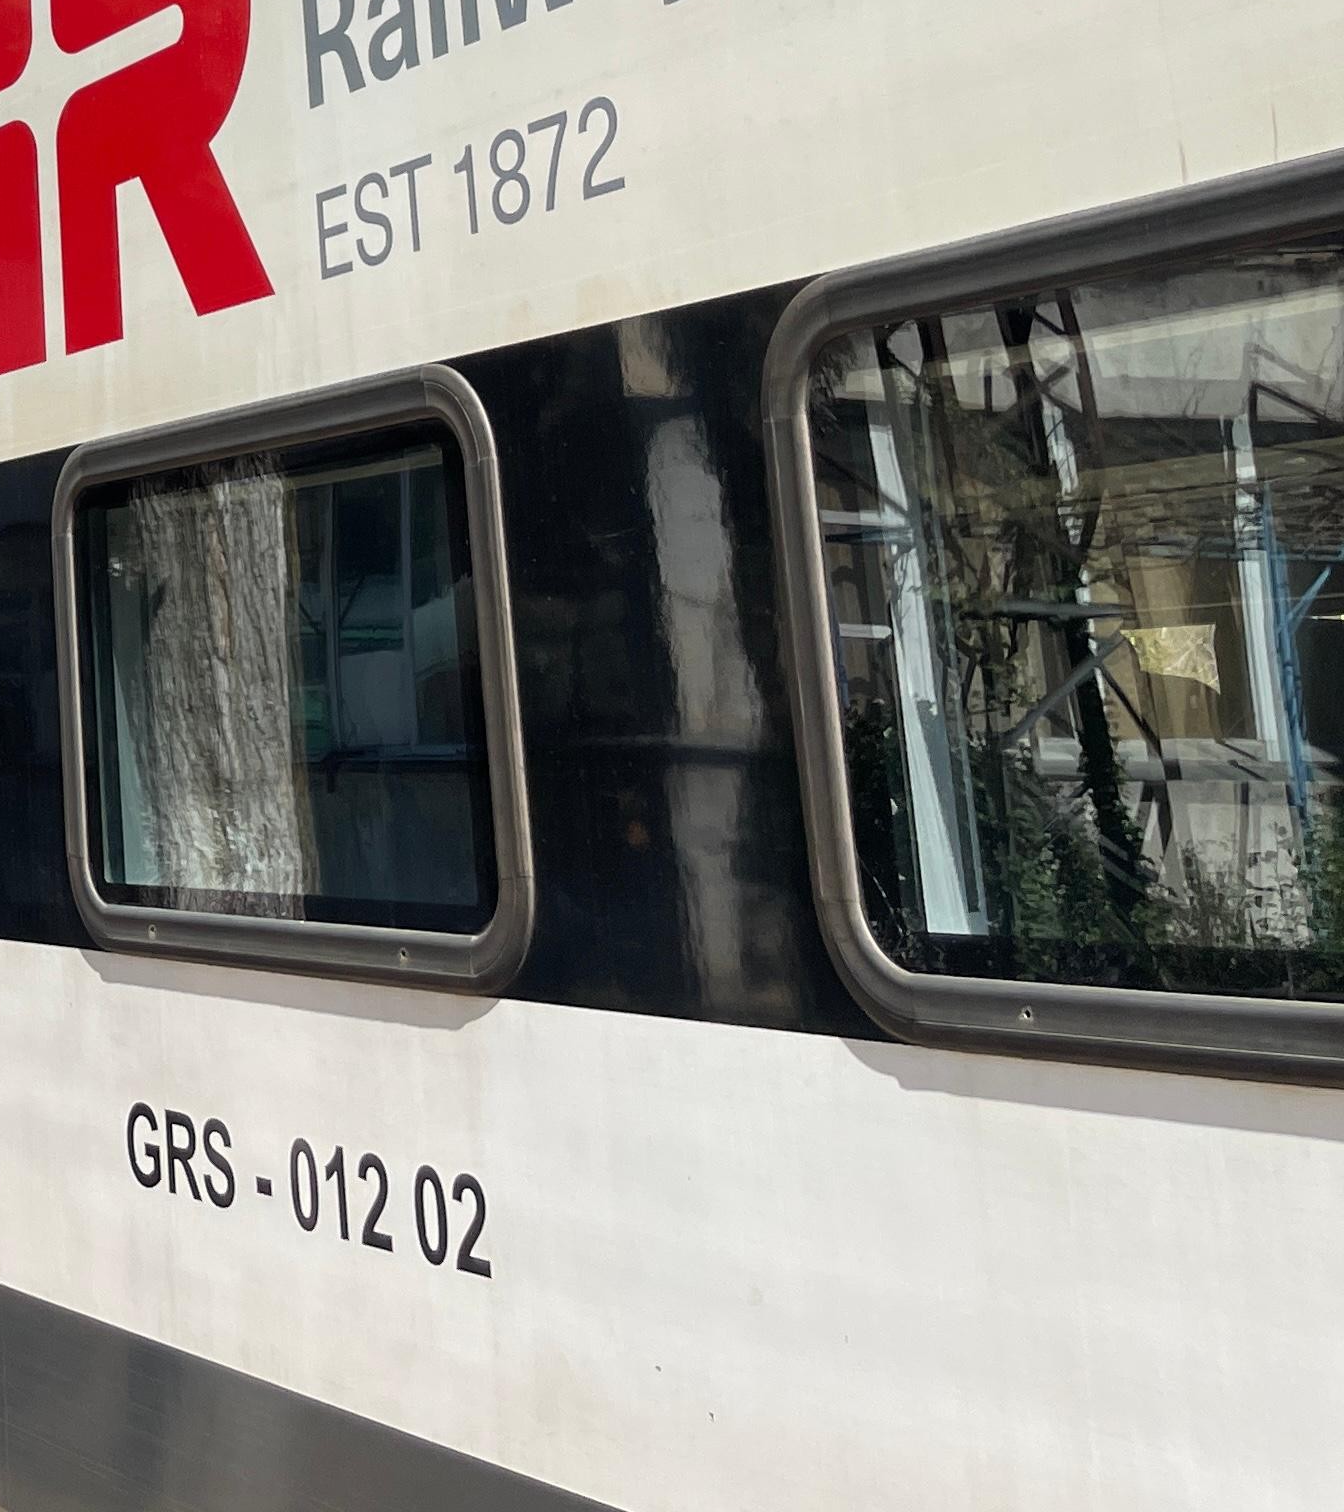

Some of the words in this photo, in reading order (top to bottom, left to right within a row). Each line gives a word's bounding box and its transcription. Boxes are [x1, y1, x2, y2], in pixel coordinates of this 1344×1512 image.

[315, 153, 432, 280] EST
[453, 96, 626, 235] 1872
[126, 1101, 236, 1210] GRS
[289, 1136, 394, 1253] 012
[413, 1163, 493, 1279] 02
